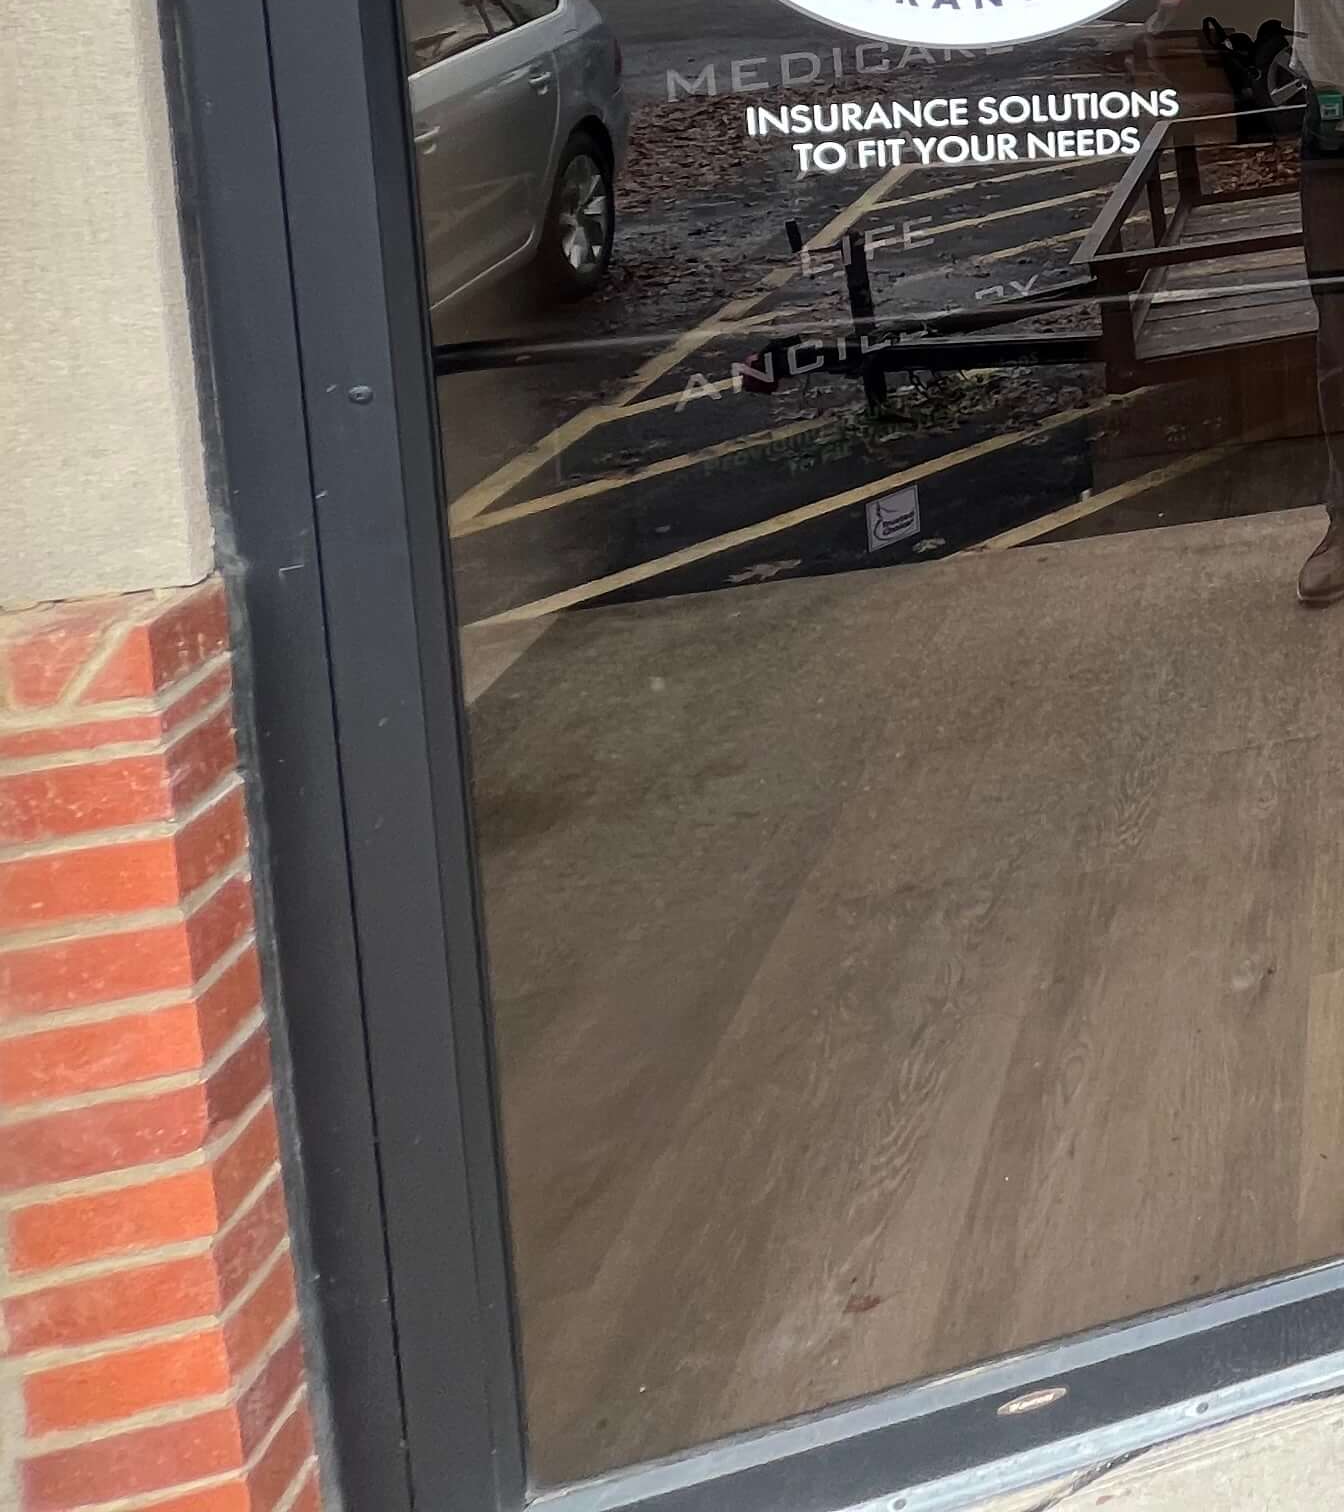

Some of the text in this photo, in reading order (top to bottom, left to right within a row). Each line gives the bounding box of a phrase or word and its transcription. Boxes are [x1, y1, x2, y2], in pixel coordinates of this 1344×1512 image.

[745, 89, 1180, 136] INSURANCE SOLUTIONS
[792, 126, 1142, 173] TO FIT YOUR NEEDS
[801, 215, 935, 277] LIFE
